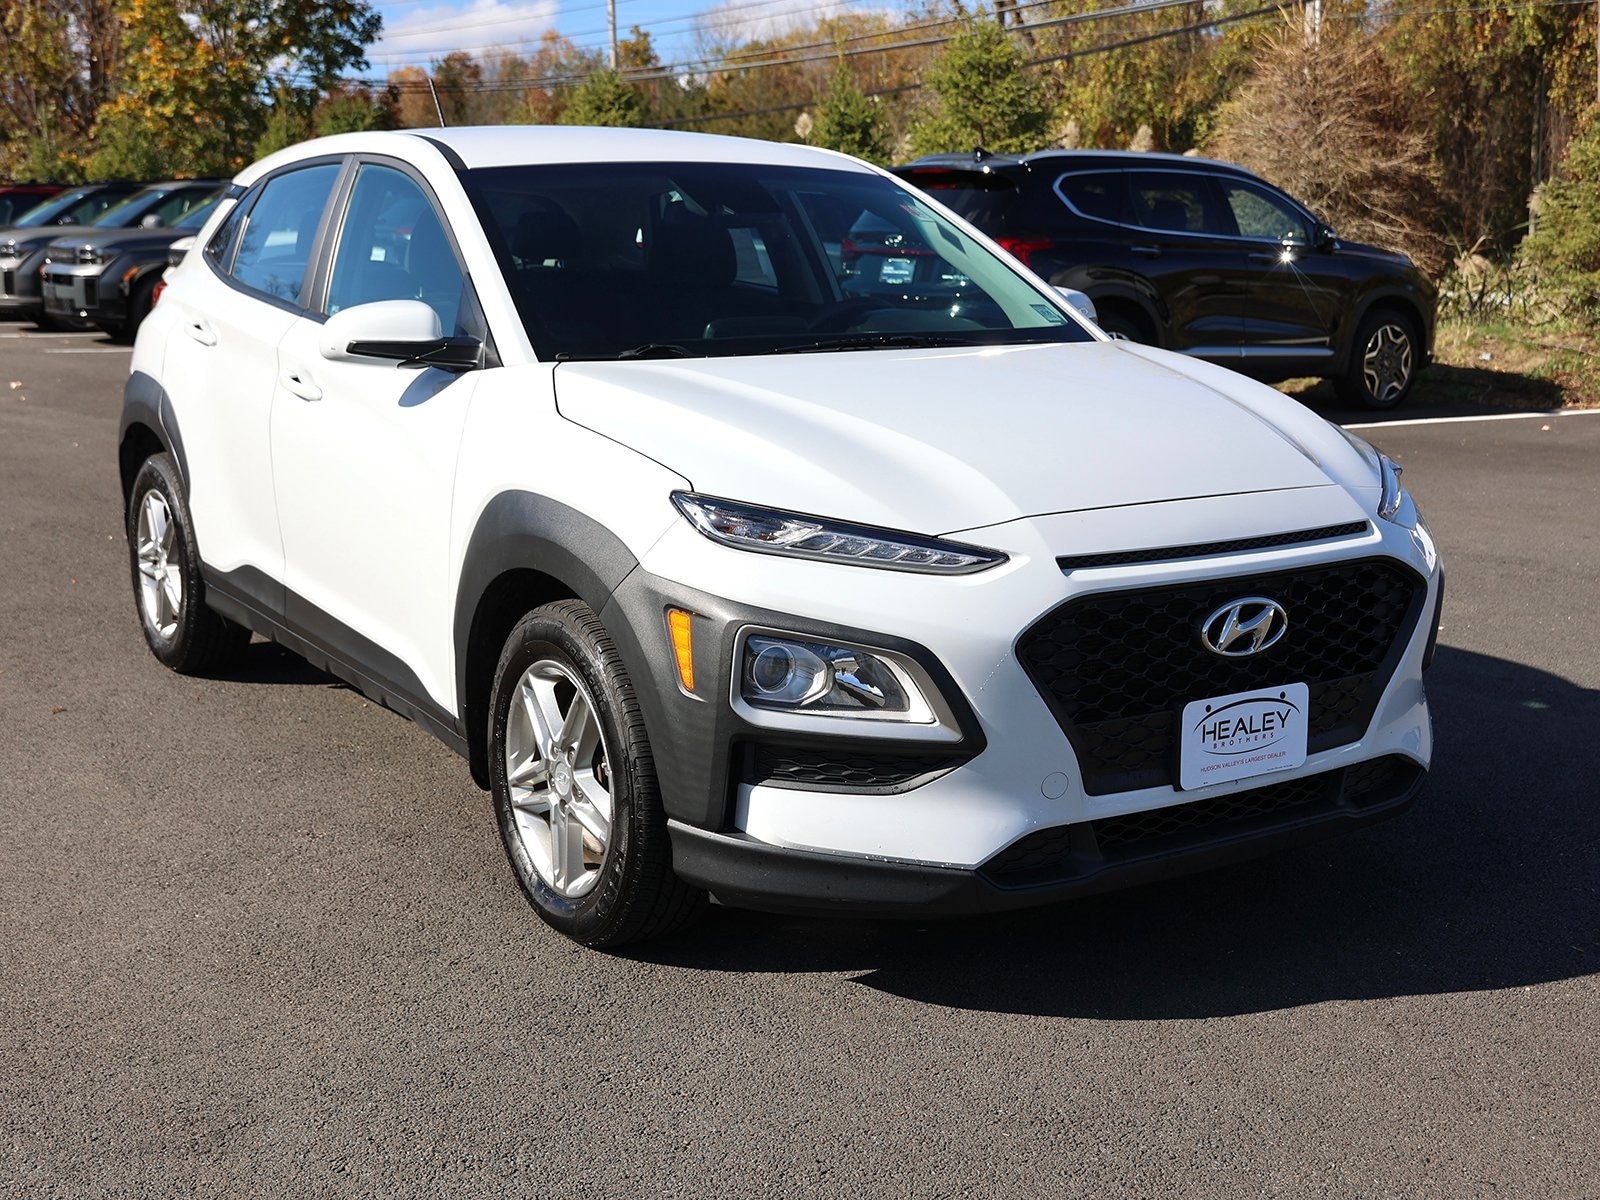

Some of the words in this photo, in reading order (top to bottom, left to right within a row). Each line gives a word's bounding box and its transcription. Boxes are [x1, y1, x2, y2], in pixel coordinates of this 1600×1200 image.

[1202, 708, 1292, 743] HEALEY
[1213, 732, 1275, 749] BROTHERS
[1200, 764, 1221, 772] HUDSON
[1222, 758, 1245, 769] VALLEY'S
[1245, 754, 1267, 764] LARGEST
[1267, 750, 1287, 760] DEALER
